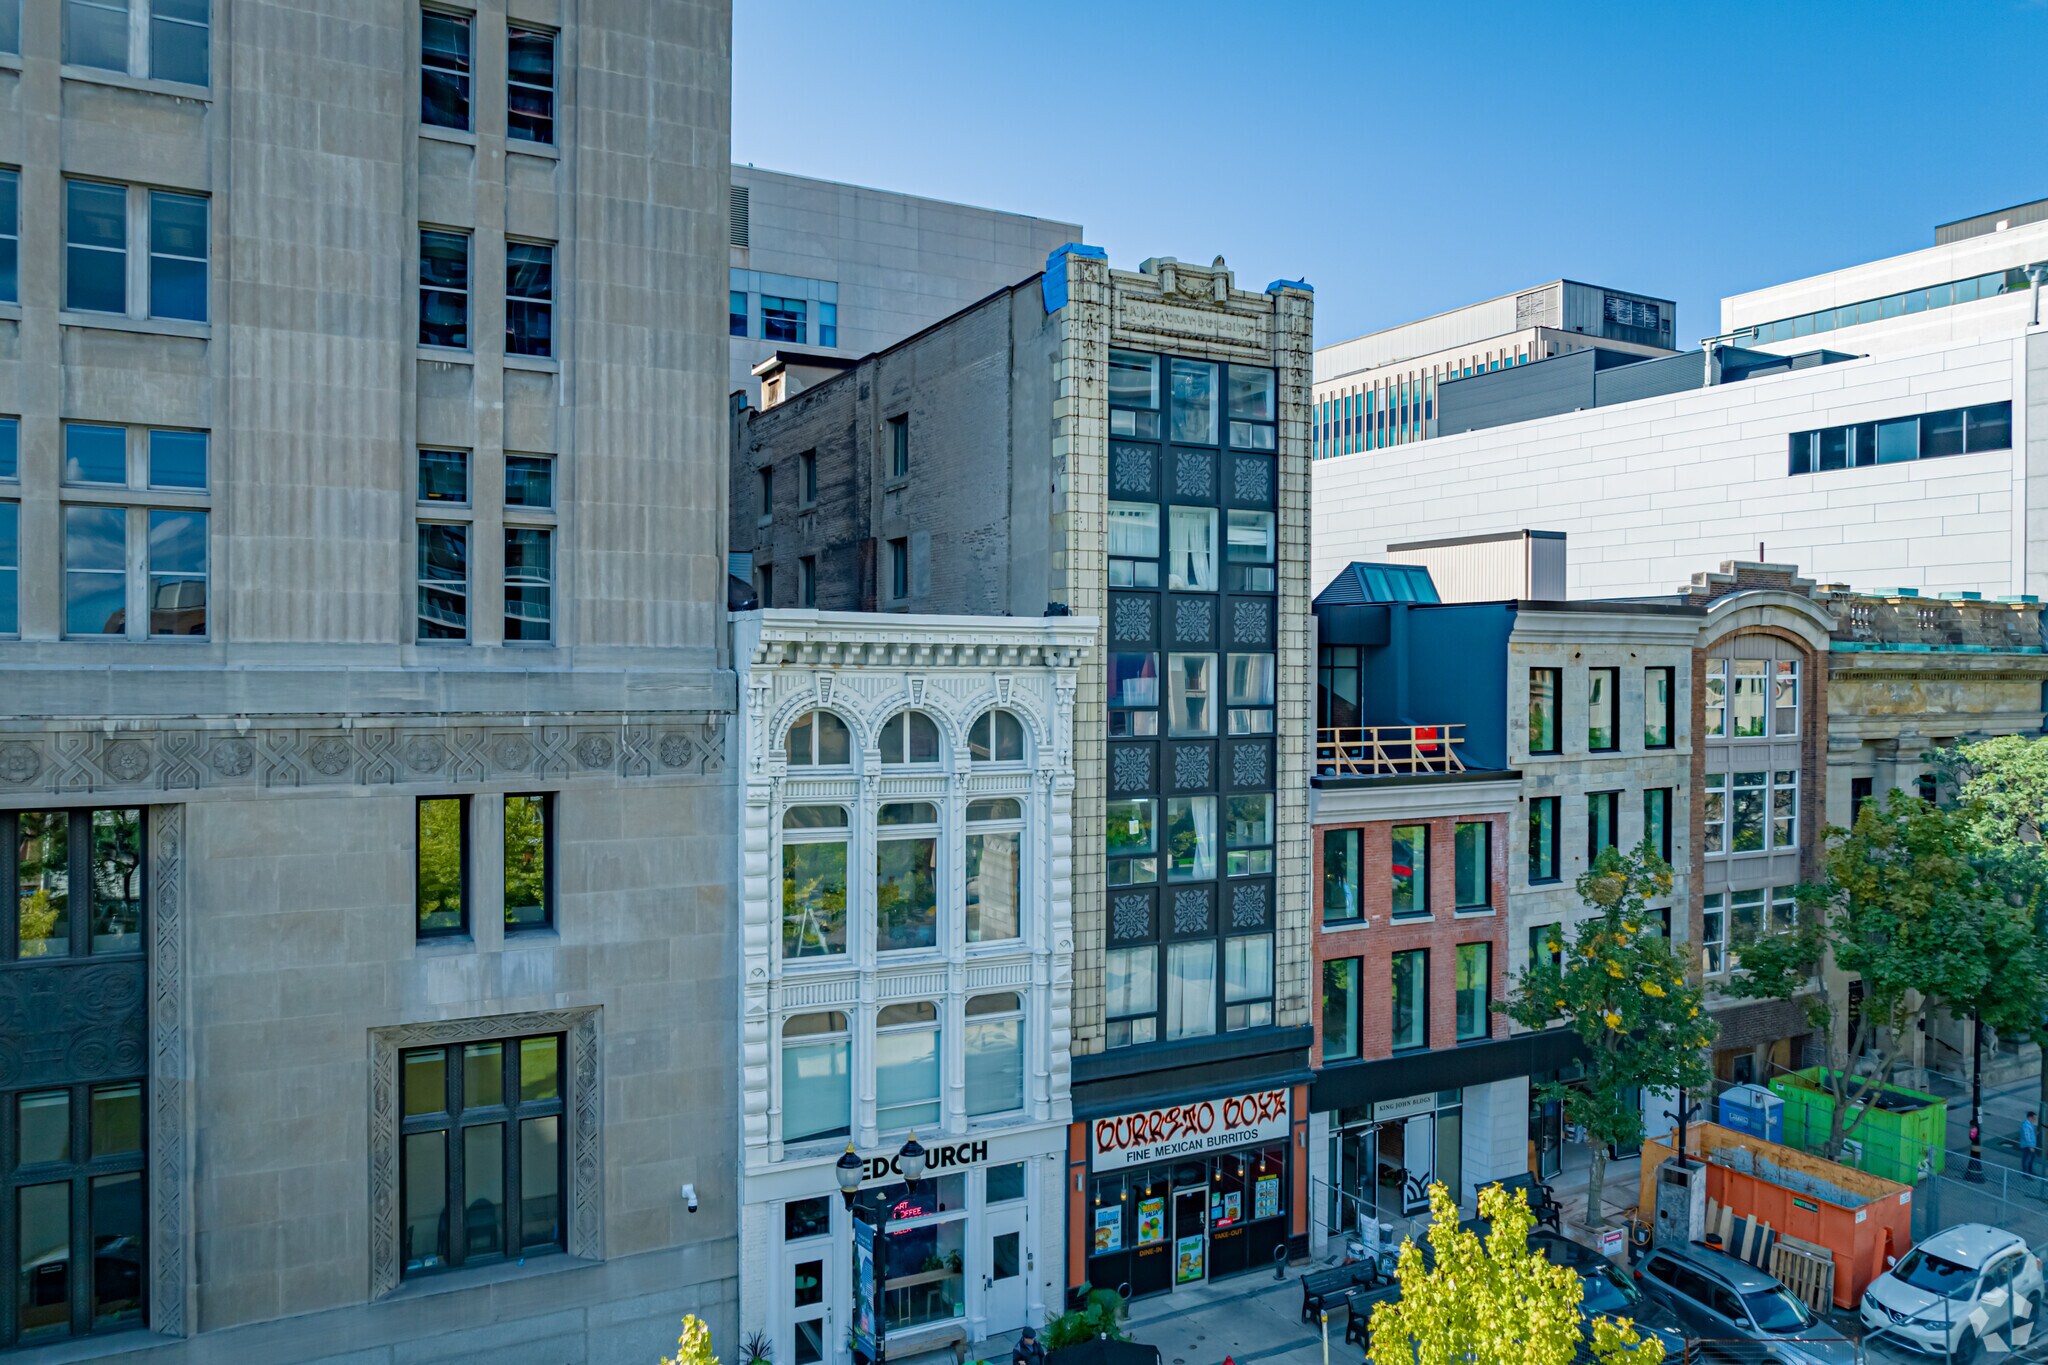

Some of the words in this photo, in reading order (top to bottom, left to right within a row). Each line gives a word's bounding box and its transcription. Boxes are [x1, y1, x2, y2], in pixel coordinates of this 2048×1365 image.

[1379, 1103, 1394, 1111] KING
[1396, 1100, 1411, 1109] JOHN
[1413, 1097, 1431, 1105] BLDGS
[1096, 1101, 1215, 1154] BURRITO
[1223, 1088, 1287, 1130] BOYZ
[1126, 1149, 1151, 1163] FINE
[1155, 1138, 1203, 1157] MEXICAN
[1207, 1129, 1259, 1147] BURRITOS
[1214, 1228, 1243, 1239] TAKE-OUT
[1139, 1246, 1163, 1257] DINE-IN
